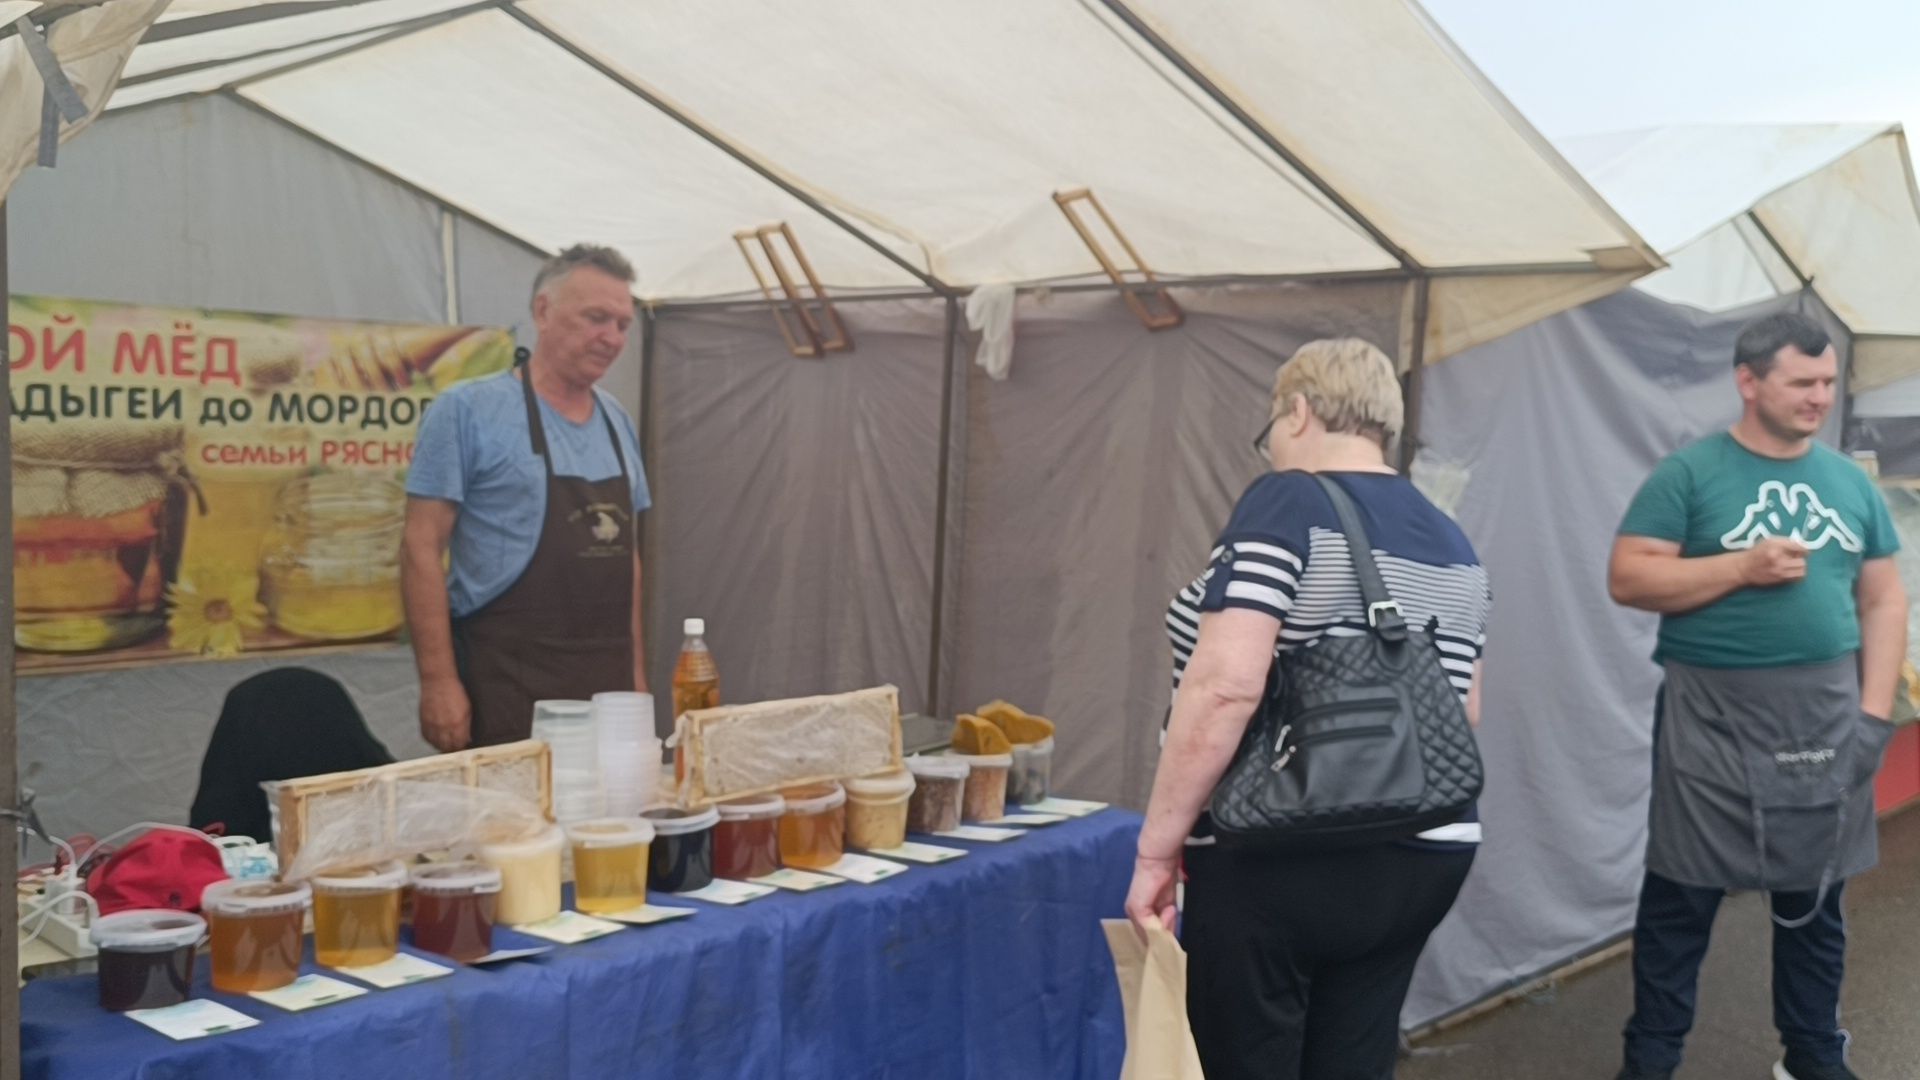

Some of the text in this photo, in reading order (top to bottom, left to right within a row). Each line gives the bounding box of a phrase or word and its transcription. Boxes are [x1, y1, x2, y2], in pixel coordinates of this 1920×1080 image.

[112, 320, 242, 387] МЁД
[199, 396, 253, 426] до
[201, 444, 308, 465] семьи
